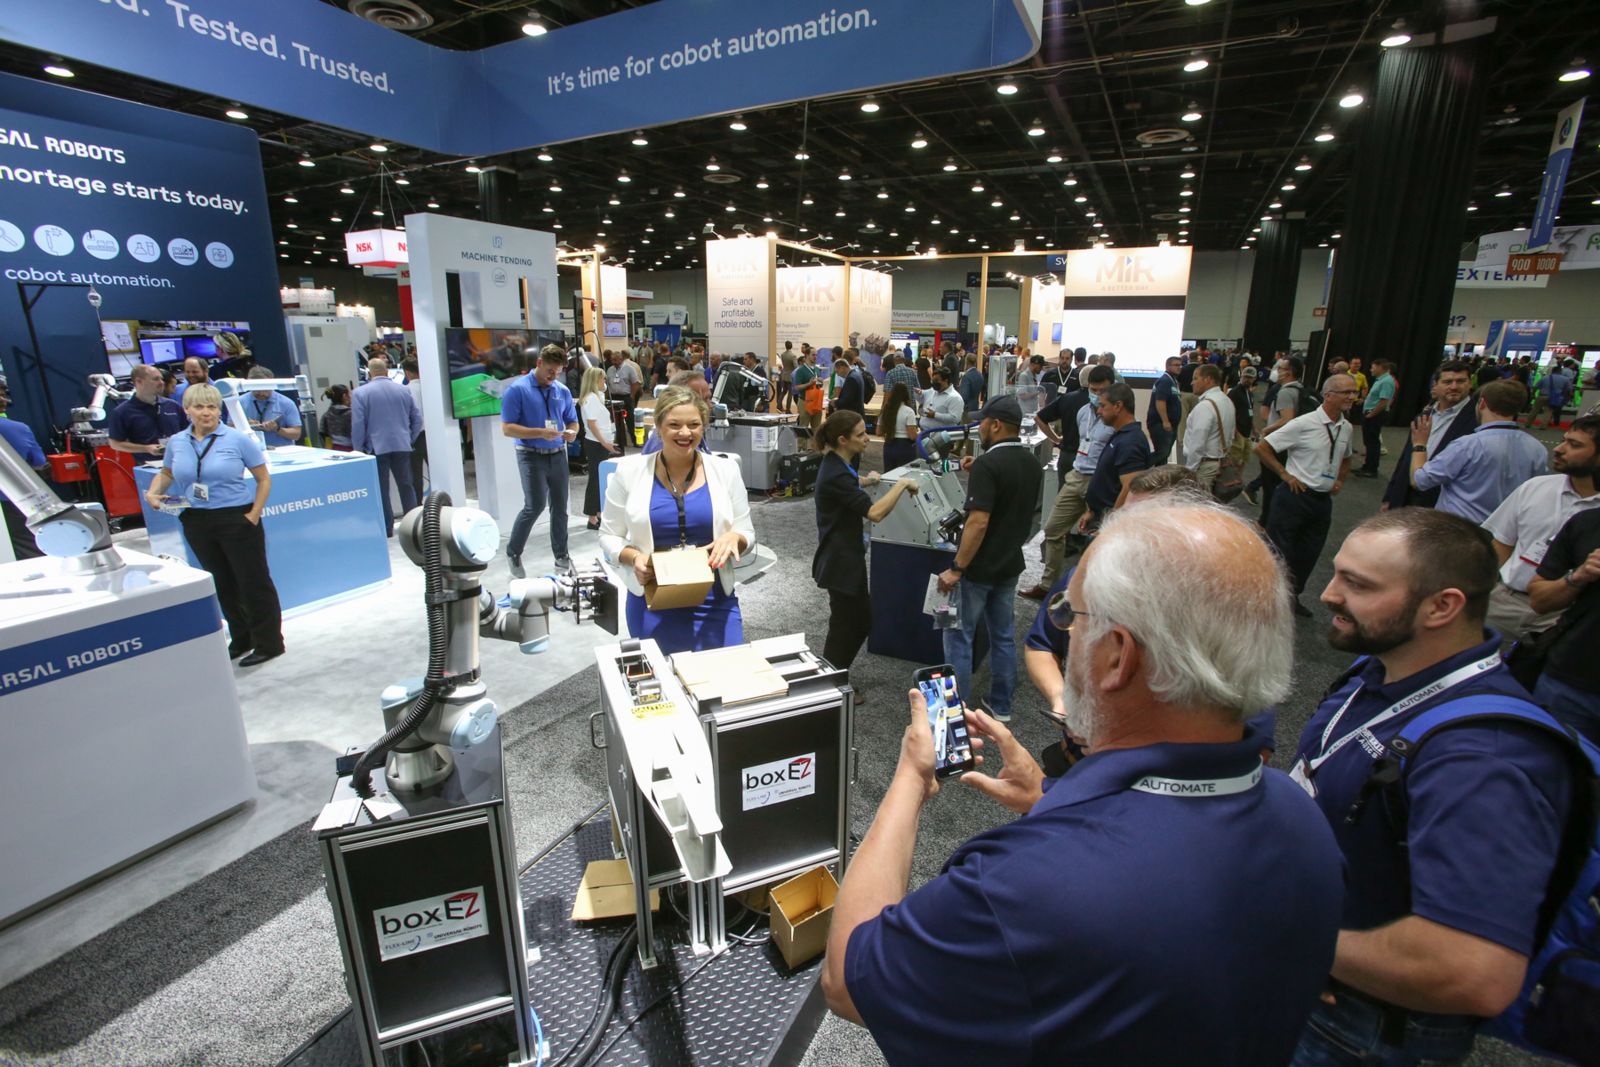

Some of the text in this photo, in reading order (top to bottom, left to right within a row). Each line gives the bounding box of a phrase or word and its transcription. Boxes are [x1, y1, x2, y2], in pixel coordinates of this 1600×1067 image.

[165, 0, 395, 95] Tested. Trusted.
[548, 7, 878, 95] It's time for cobot automation.
[44, 136, 127, 164] ROBOTS
[112, 181, 182, 204] starts
[186, 190, 249, 215] today.
[356, 242, 373, 253] NSK
[461, 251, 533, 267] MACHINE TENDING
[1511, 257, 1557, 271] 900 1000
[4, 266, 176, 289] cobot automation.
[721, 308, 755, 319] profitable
[722, 297, 753, 307] Safe and
[714, 320, 763, 329] mobile robots
[261, 488, 368, 518] UNIVERSAL ROBOTS
[66, 637, 144, 670] ROBOTS
[1399, 683, 1445, 710] AUTOMATE
[1140, 778, 1216, 793] AUTOMATE
